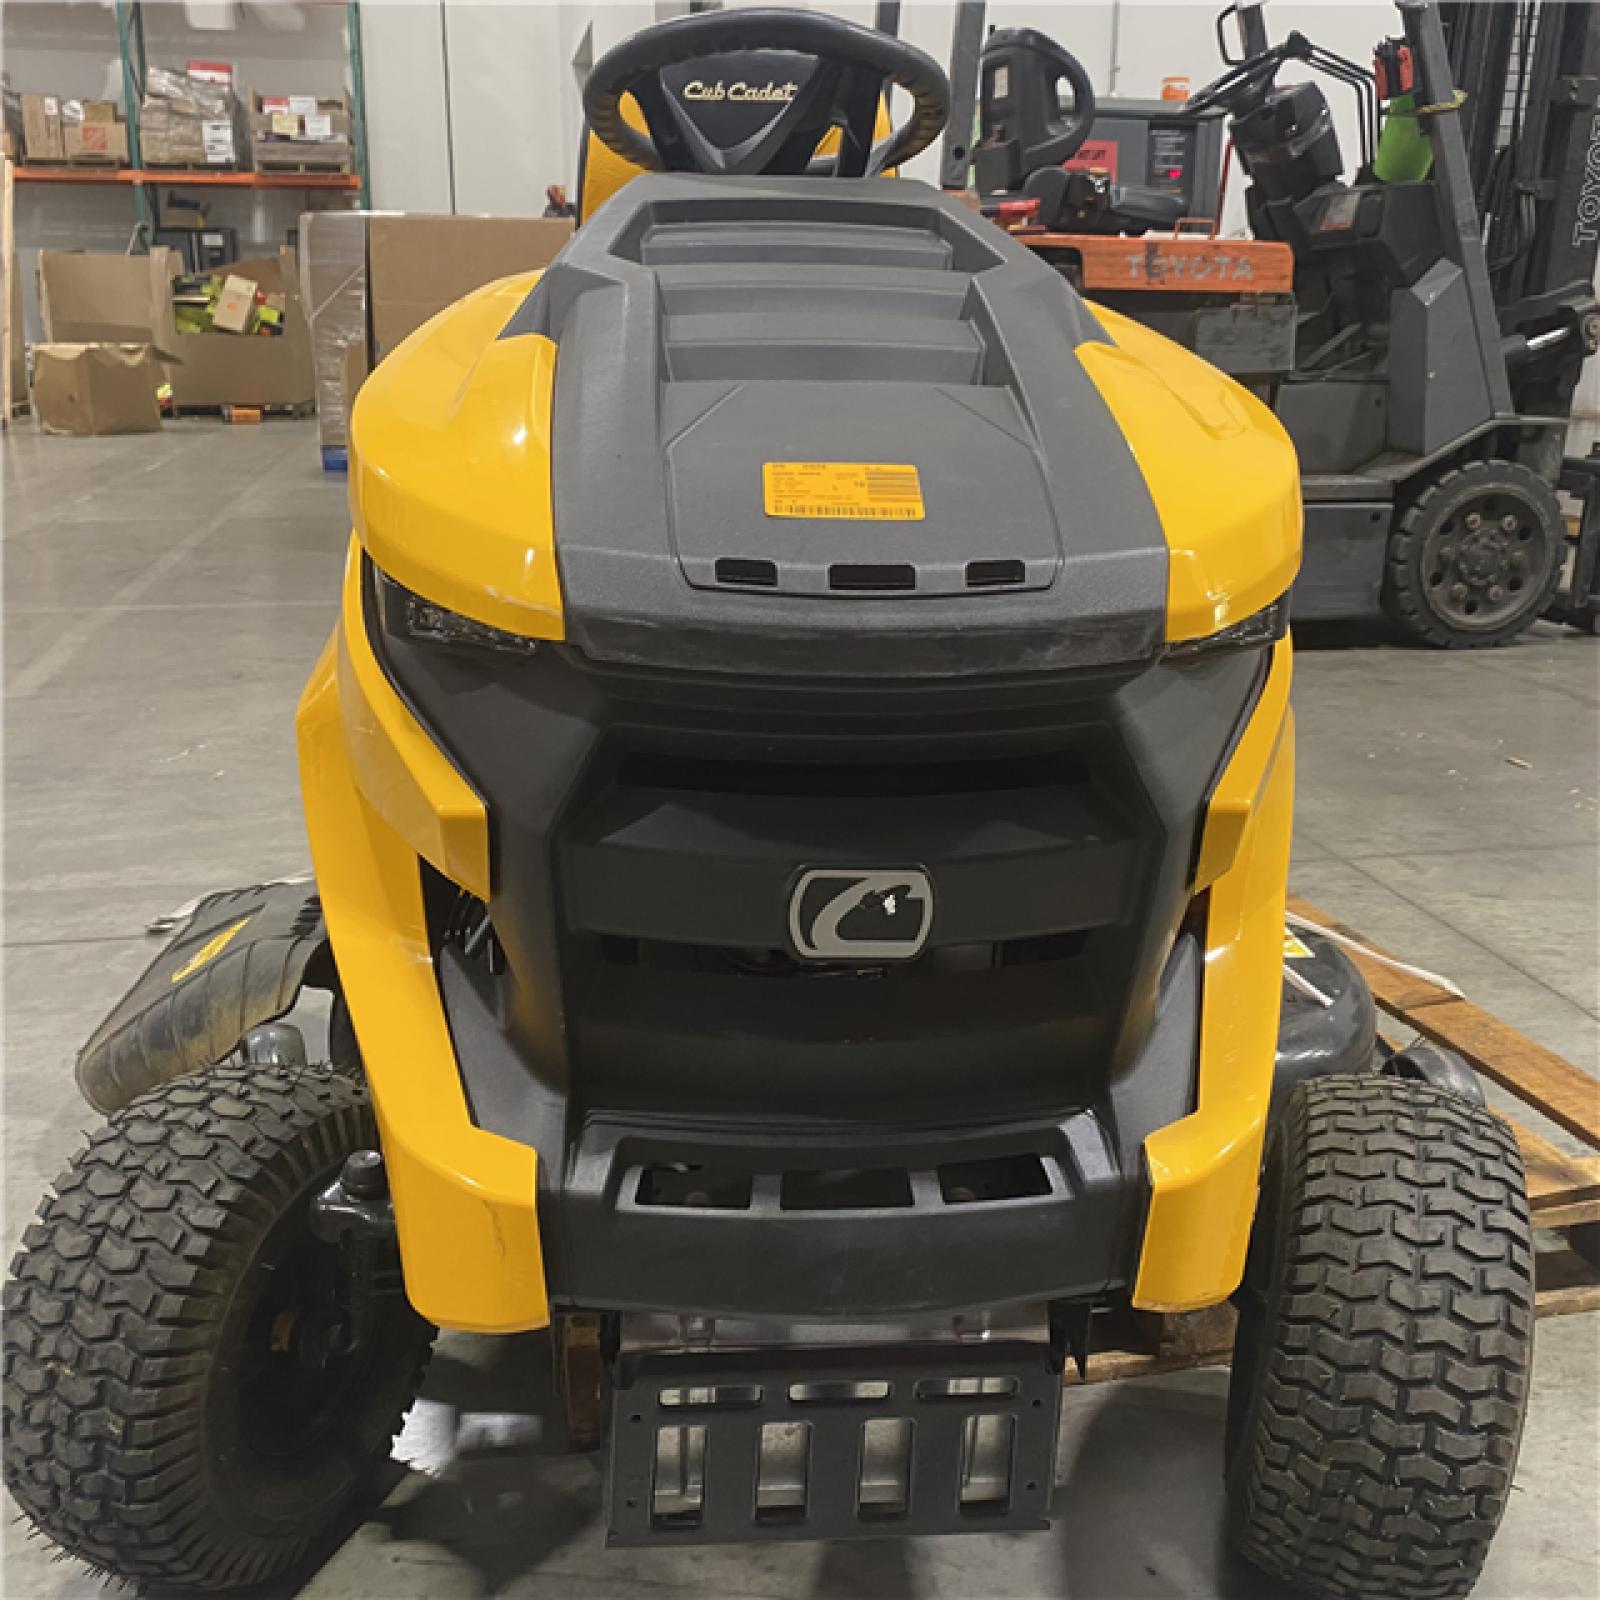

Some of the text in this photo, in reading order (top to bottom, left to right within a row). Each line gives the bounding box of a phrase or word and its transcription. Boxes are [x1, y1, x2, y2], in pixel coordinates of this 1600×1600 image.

[683, 80, 799, 101] Cub Cadet
[1125, 254, 1254, 281] TOYOTA
